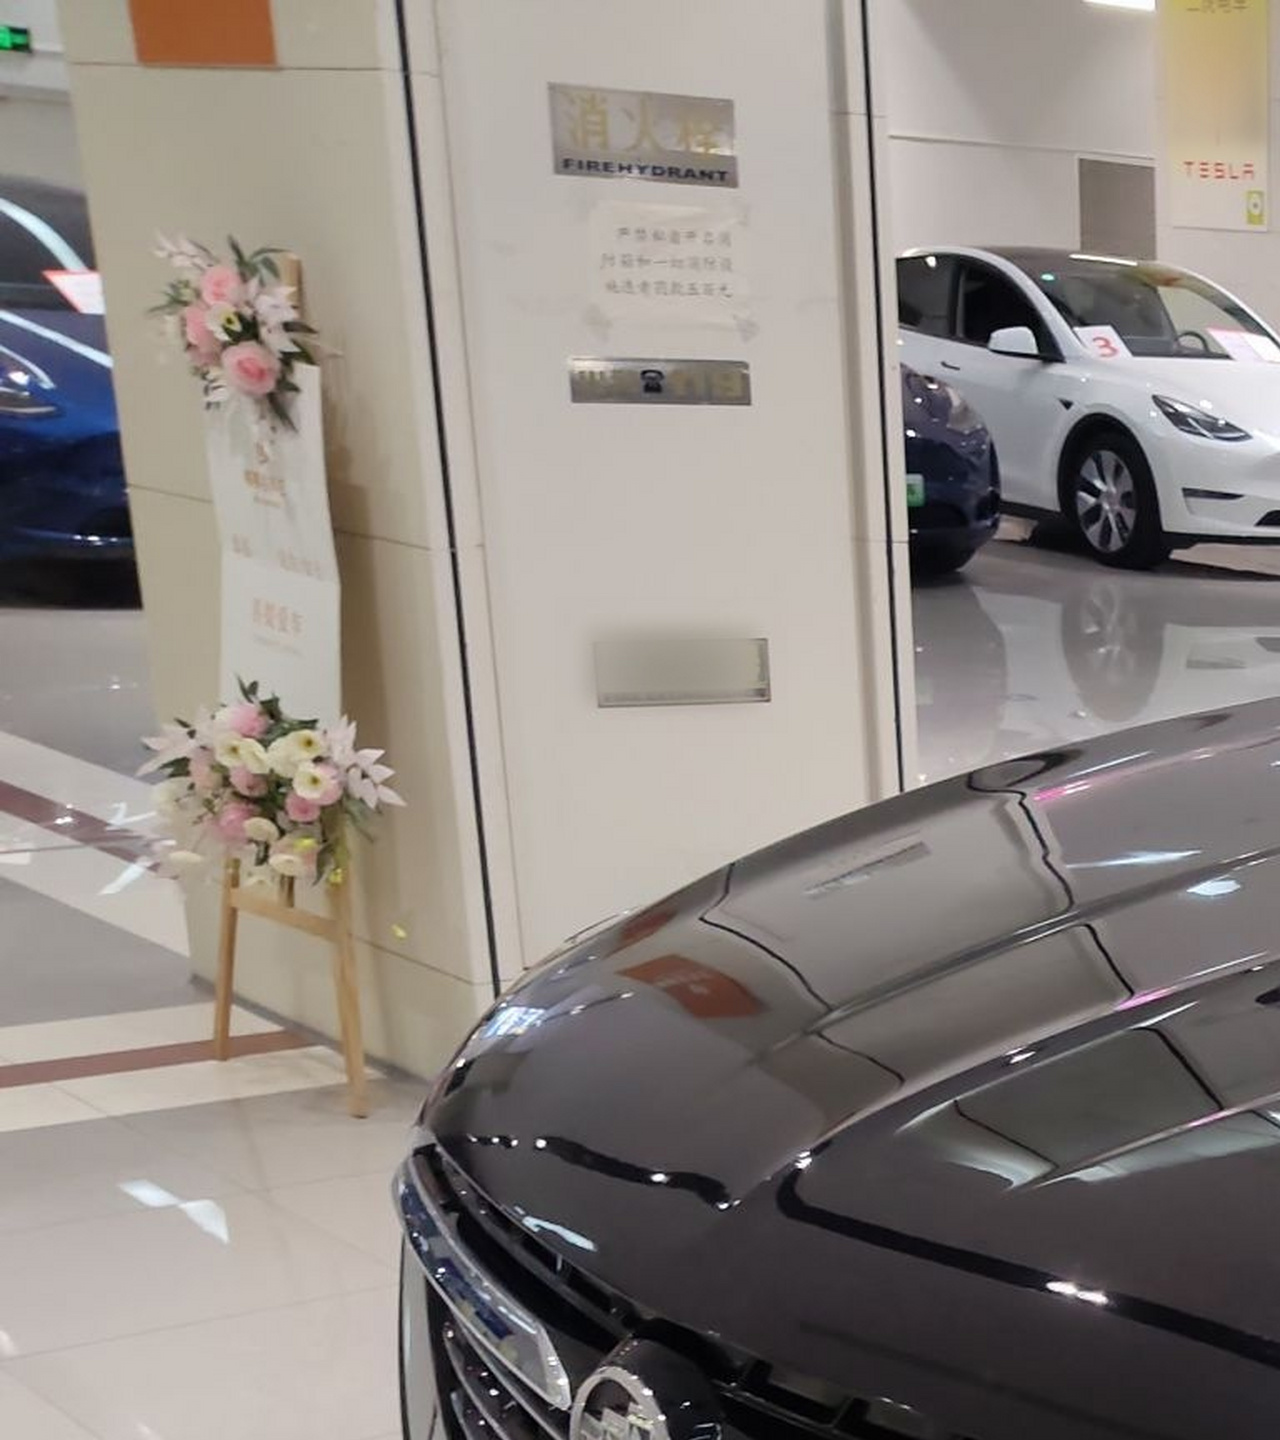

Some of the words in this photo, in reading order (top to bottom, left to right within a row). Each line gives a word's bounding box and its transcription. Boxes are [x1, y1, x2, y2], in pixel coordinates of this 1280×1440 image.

[562, 157, 729, 182] FIREHYDRANT
[1183, 160, 1255, 180] TESLA
[1092, 336, 1119, 358] 3
